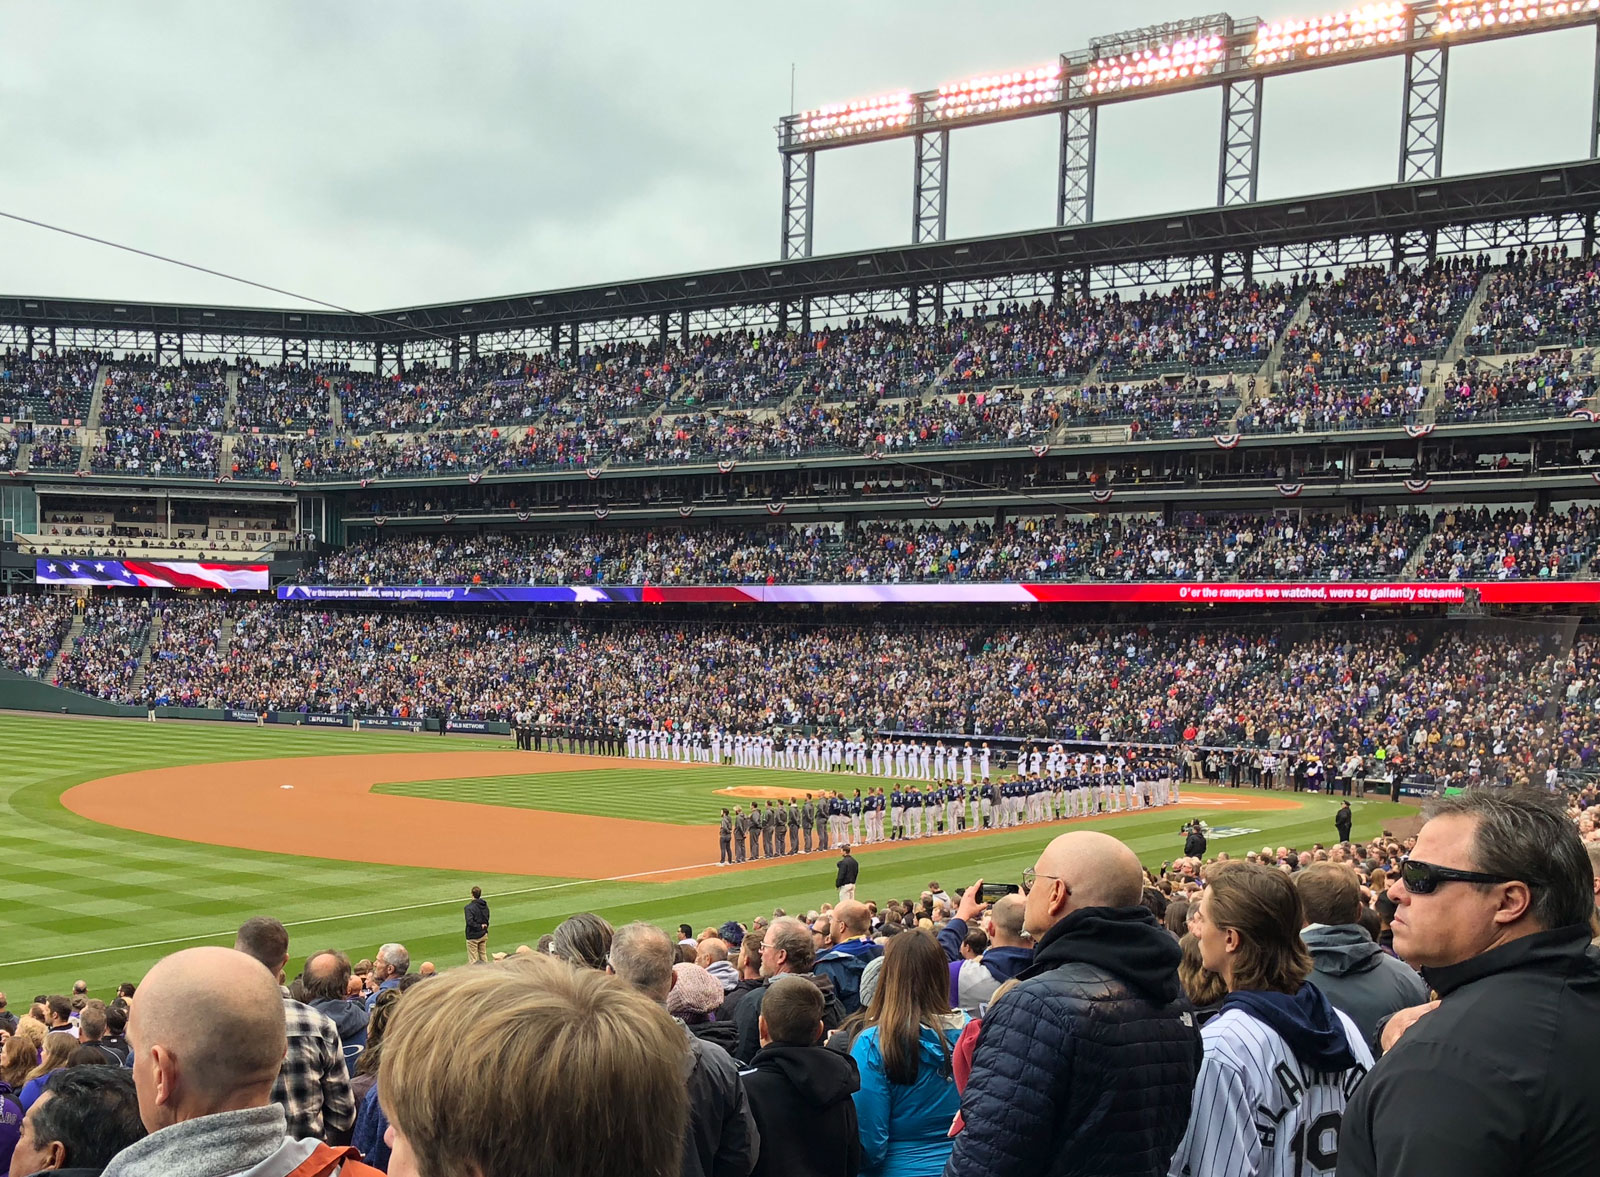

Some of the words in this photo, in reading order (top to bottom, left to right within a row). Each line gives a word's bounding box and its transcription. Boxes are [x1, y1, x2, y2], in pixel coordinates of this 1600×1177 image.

[1180, 587, 1200, 597] O'er
[1202, 587, 1218, 597] the
[1220, 588, 1264, 599] ramparts
[1265, 589, 1279, 597] we
[1281, 587, 1327, 599] watched,
[1329, 589, 1353, 598] were
[1356, 589, 1368, 598] so
[1370, 587, 1415, 600] gallantly
